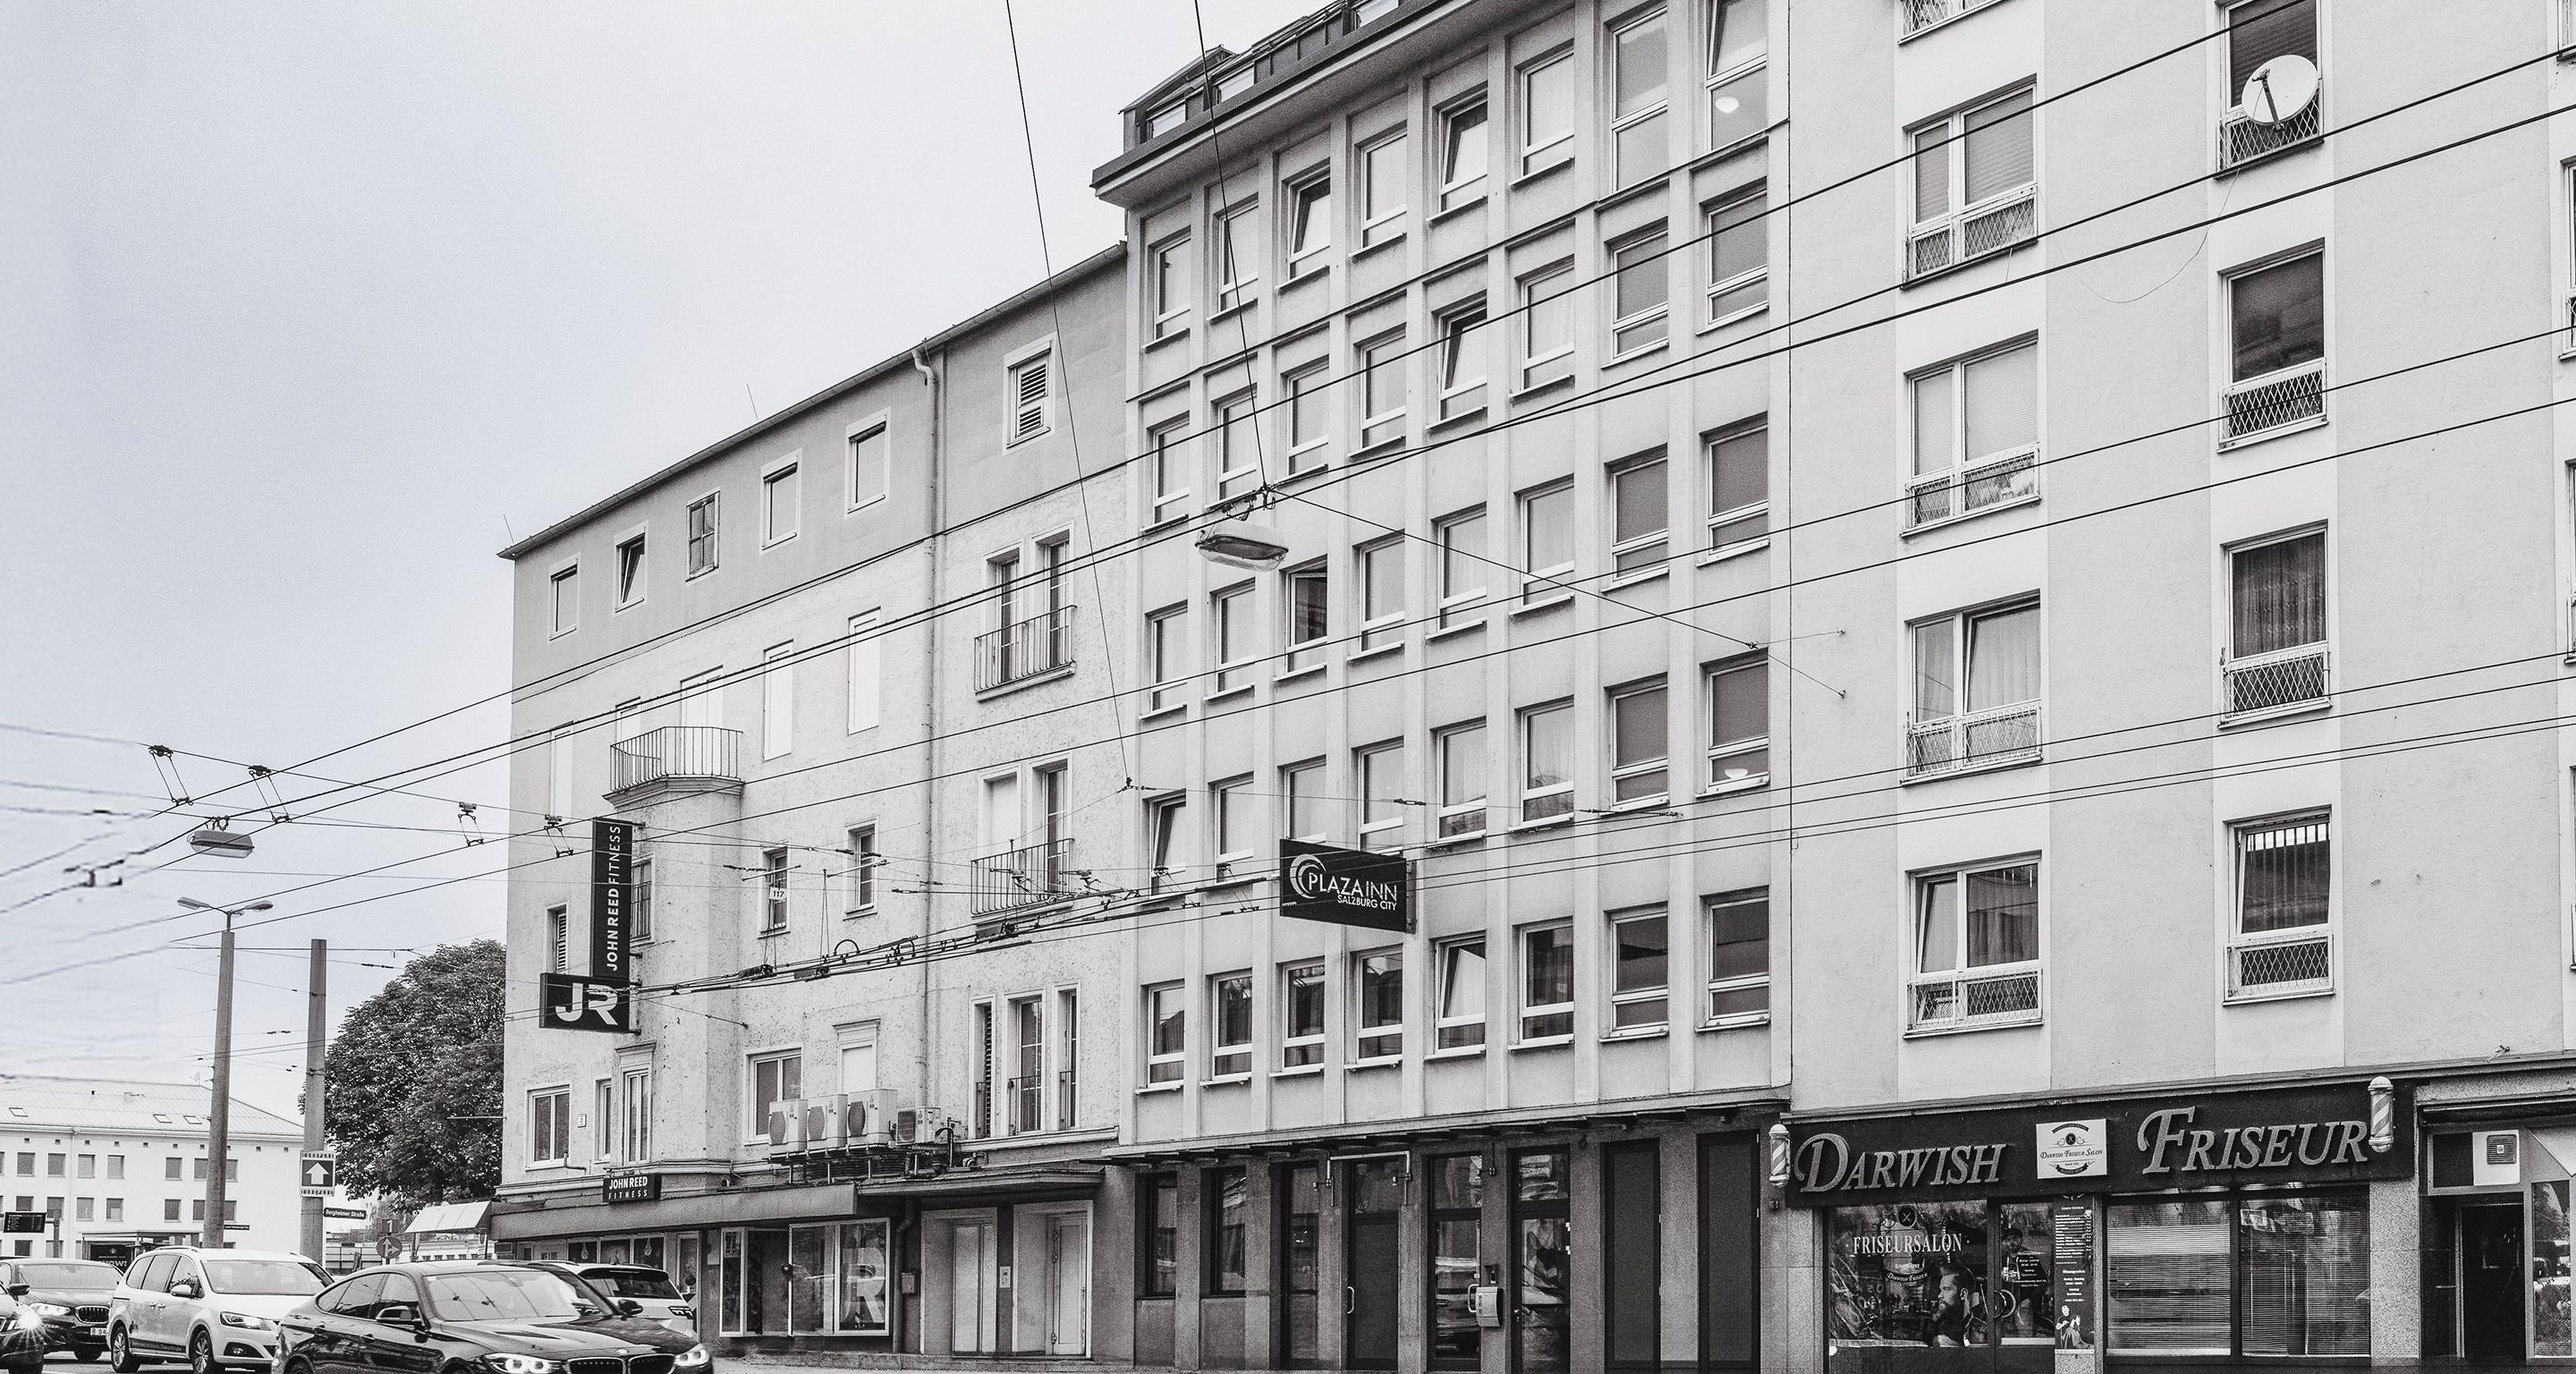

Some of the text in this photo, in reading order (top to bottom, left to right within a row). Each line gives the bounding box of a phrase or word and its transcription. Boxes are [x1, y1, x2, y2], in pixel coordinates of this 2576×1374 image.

[606, 826, 621, 971] JOHN REED FITNESS
[1309, 872, 1397, 903] PLAZA INN
[1337, 895, 1397, 911] SALZBURG CITY
[555, 982, 619, 1026] JR
[2137, 1106, 2368, 1174] FRISEUR
[1793, 1132, 2006, 1192] DARWISH
[608, 1175, 648, 1191] JOHN REED
[608, 1189, 648, 1200] FITNESS
[1853, 1233, 1962, 1254] FRISEURSALON
